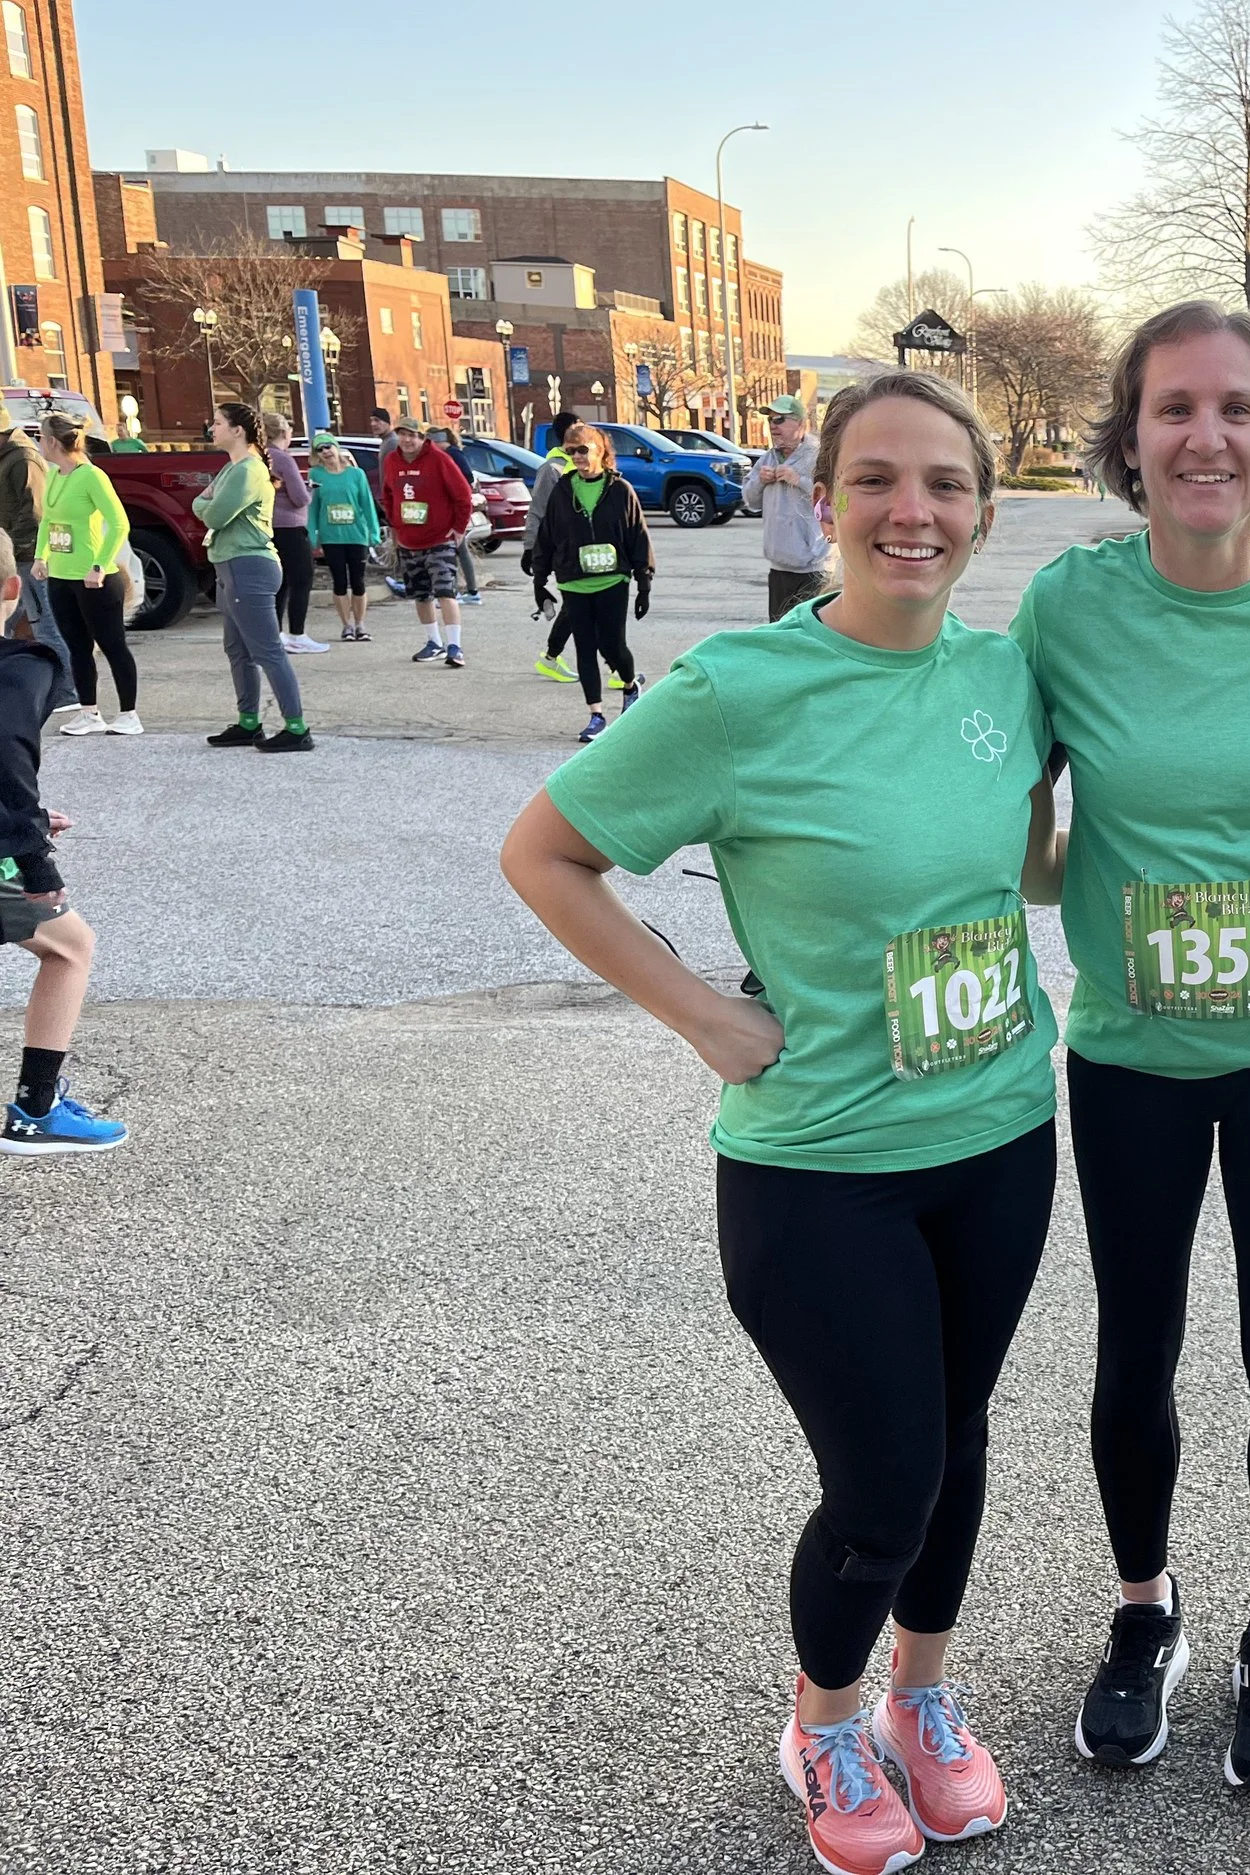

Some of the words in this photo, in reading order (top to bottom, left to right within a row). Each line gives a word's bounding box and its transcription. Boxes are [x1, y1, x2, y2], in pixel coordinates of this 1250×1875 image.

[297, 305, 313, 385] Emergency
[444, 405, 461, 415] STOP
[583, 552, 615, 567] 1385
[1124, 895, 1132, 916] BEER
[886, 951, 895, 973] BEER
[1127, 957, 1136, 979] FOOD
[909, 947, 1022, 1038] 1022
[891, 1018, 901, 1043] FOOD
[799, 1747, 828, 1823] HOKA
